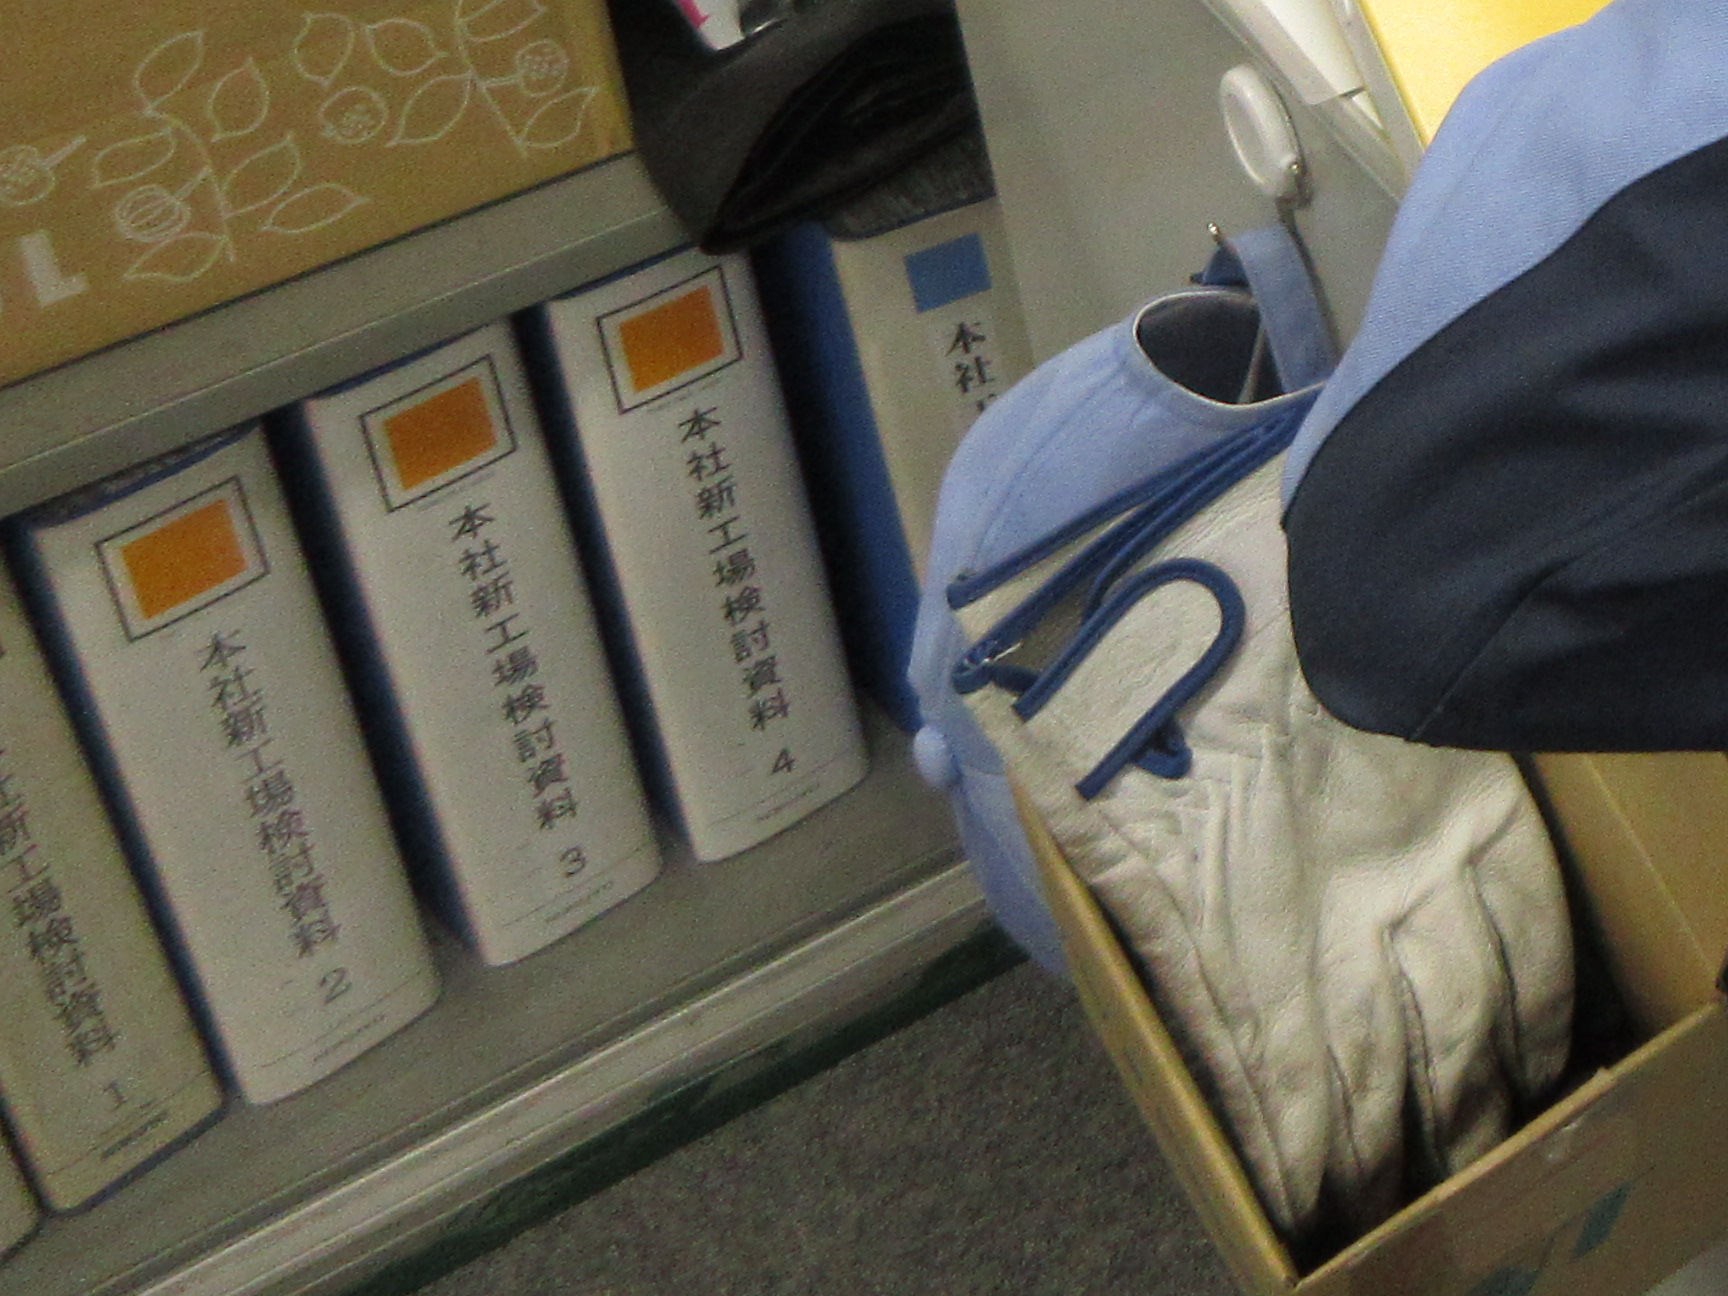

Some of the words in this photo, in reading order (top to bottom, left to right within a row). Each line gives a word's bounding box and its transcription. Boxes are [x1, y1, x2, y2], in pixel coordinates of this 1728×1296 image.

[18, 231, 88, 306] L
[945, 322, 998, 412] 本社
[448, 502, 579, 830] 本社新工場検討資料
[558, 846, 587, 878] 3
[678, 407, 790, 731] 本社新工場検討資料
[770, 747, 797, 776] 4
[199, 630, 342, 958] 本社新工場検討資料
[318, 965, 352, 1005] 2
[103, 1077, 126, 1110] 1
